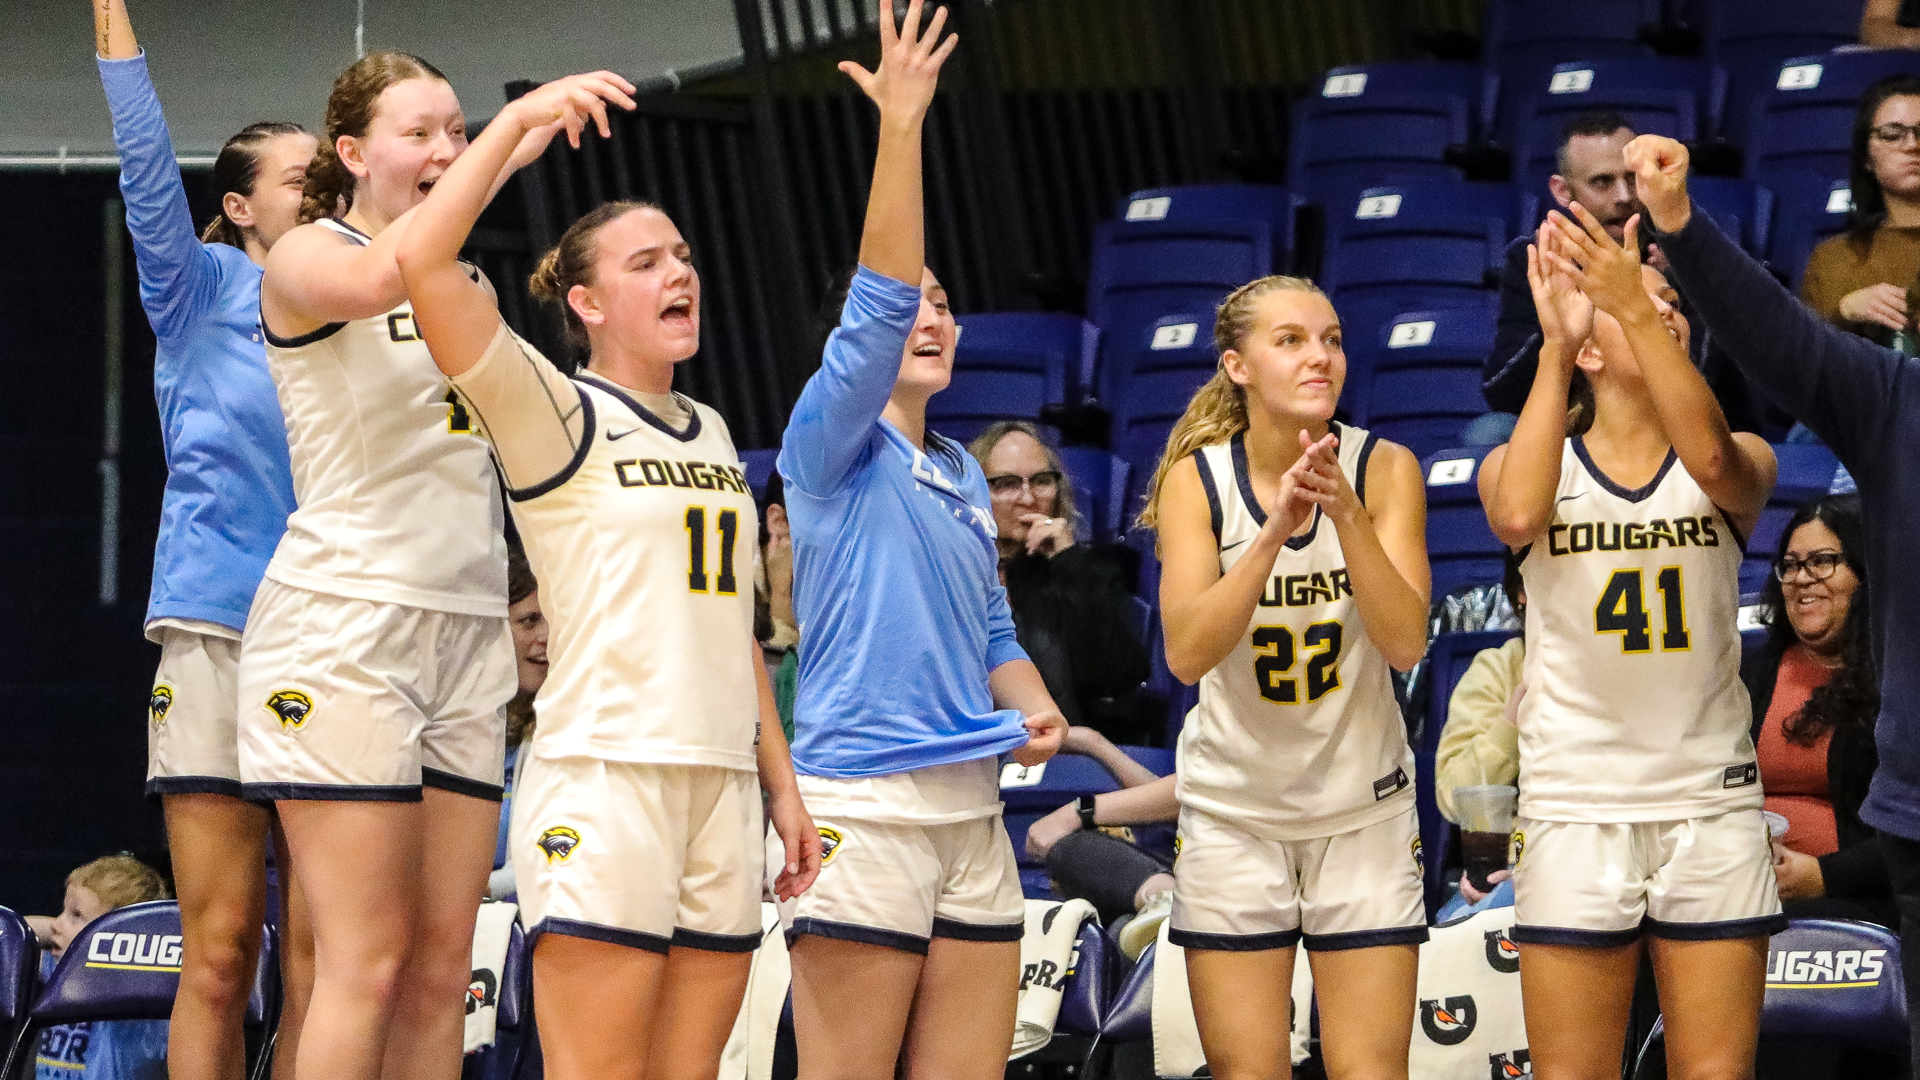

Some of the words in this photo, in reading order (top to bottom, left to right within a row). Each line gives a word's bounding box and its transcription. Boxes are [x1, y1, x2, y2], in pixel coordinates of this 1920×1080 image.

[1566, 75, 1577, 88] 2
[1796, 70, 1807, 83] 3
[1374, 200, 1385, 213] 2
[1170, 328, 1181, 342] 2
[1407, 326, 1418, 341] 3
[1446, 465, 1458, 478] 4
[1549, 515, 1720, 556] COUGARS
[684, 504, 739, 596] 11
[1594, 564, 1692, 654] 41
[1251, 618, 1344, 705] 22
[1017, 766, 1029, 780] 4
[1420, 994, 1477, 1046] G
